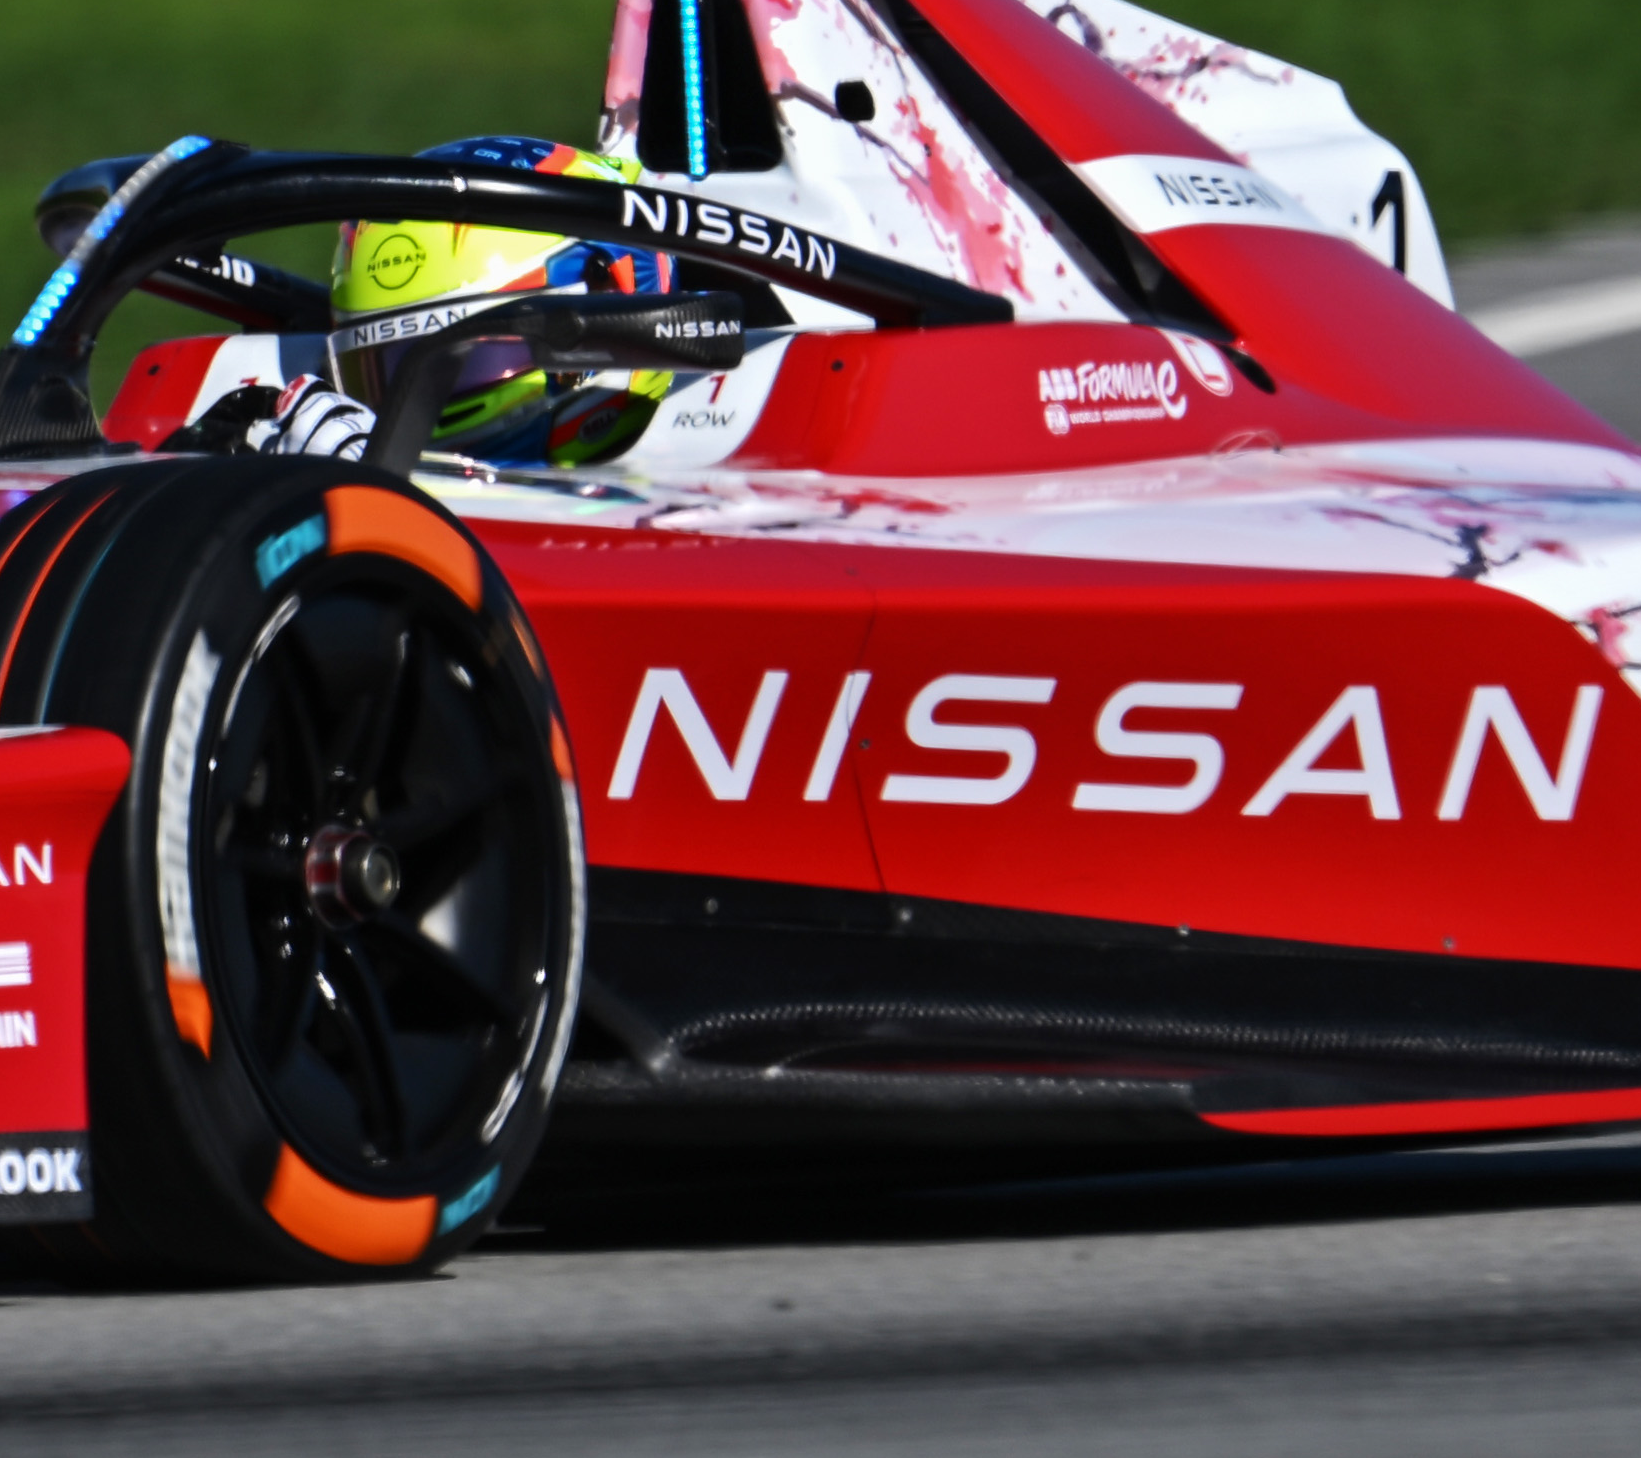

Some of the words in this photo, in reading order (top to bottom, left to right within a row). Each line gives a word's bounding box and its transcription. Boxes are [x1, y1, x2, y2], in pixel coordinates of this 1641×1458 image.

[1154, 172, 1284, 213] NISSAN
[622, 189, 837, 281] NISSAN
[1371, 169, 1408, 279] 1
[367, 252, 427, 273] NISSAN
[354, 305, 468, 346] NISSAN
[655, 320, 741, 339] NISSAN
[709, 374, 728, 405] 1
[1038, 367, 1078, 402] ABB
[672, 410, 735, 430] ROW
[606, 667, 1604, 822] NISSAN
